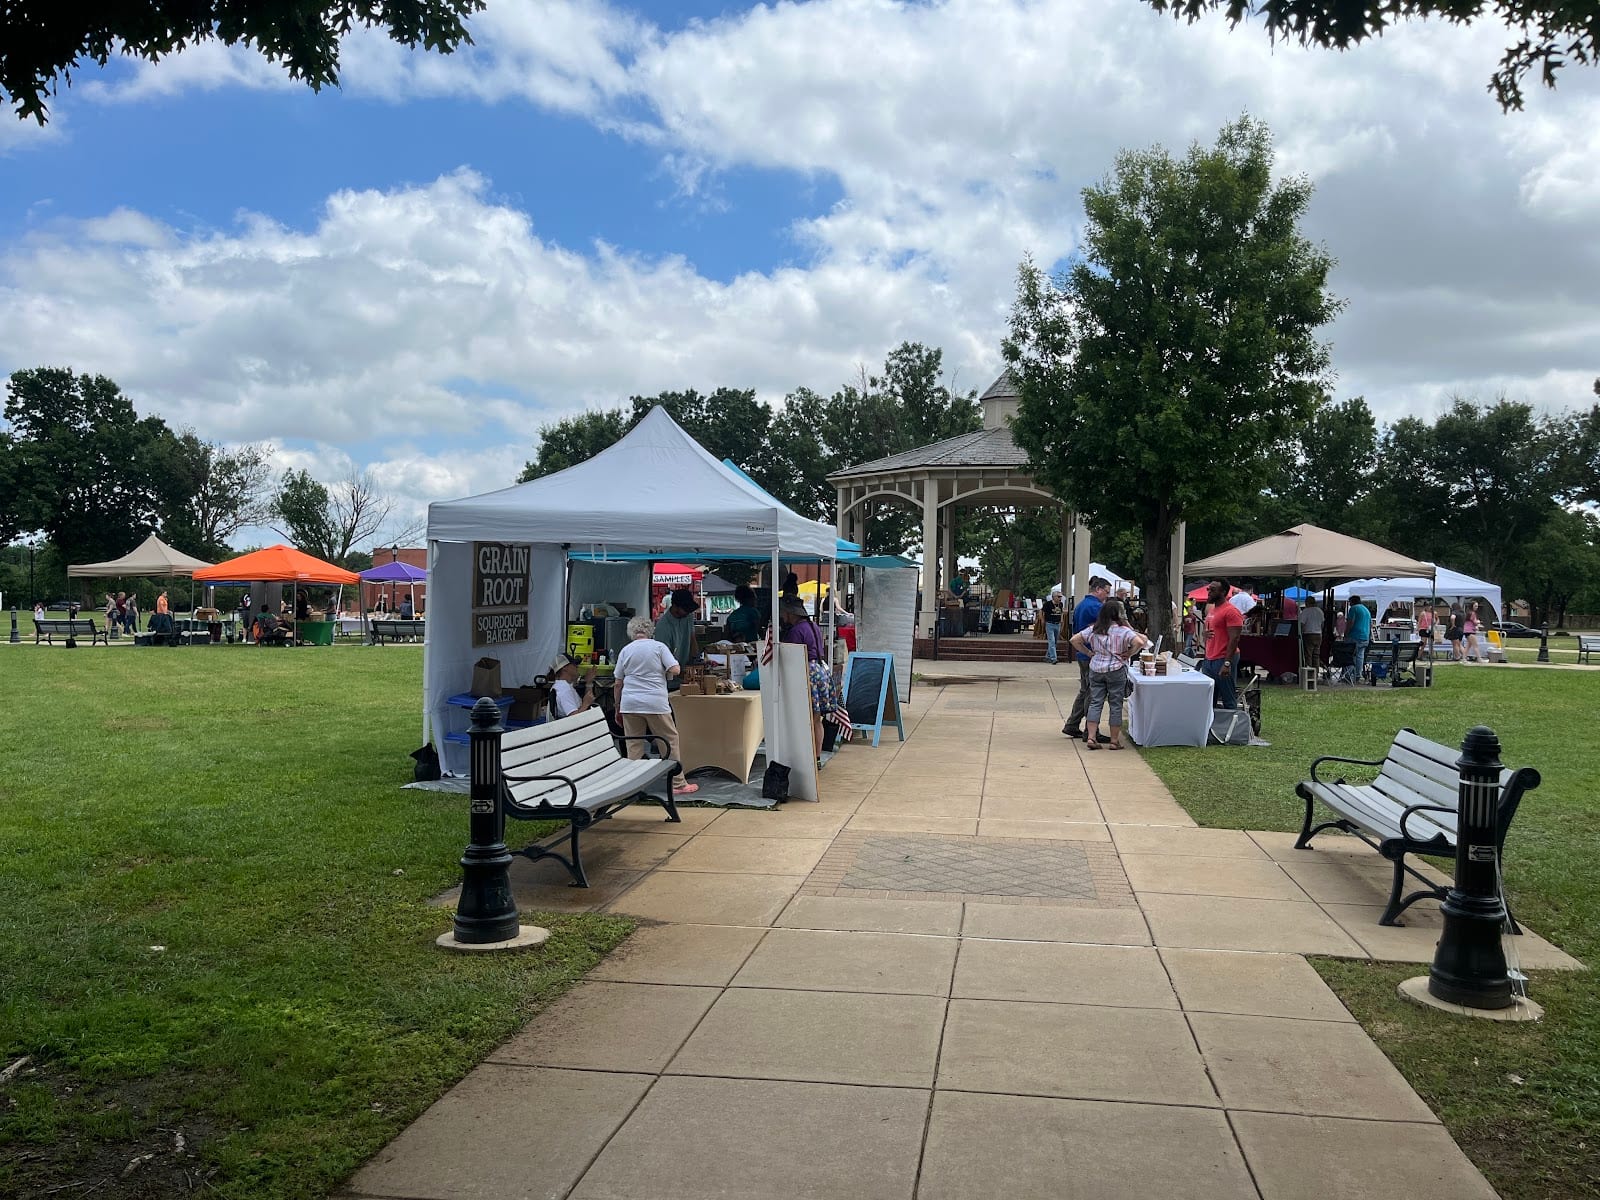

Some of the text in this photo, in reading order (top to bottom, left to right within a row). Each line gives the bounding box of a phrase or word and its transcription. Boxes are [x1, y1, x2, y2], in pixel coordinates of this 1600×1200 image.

[478, 546, 528, 575] GRAIN
[653, 575, 691, 583] SAMPLES
[482, 577, 523, 606] ROOT
[477, 614, 525, 632] SOURDOUGH
[486, 627, 518, 645] BAKERY
